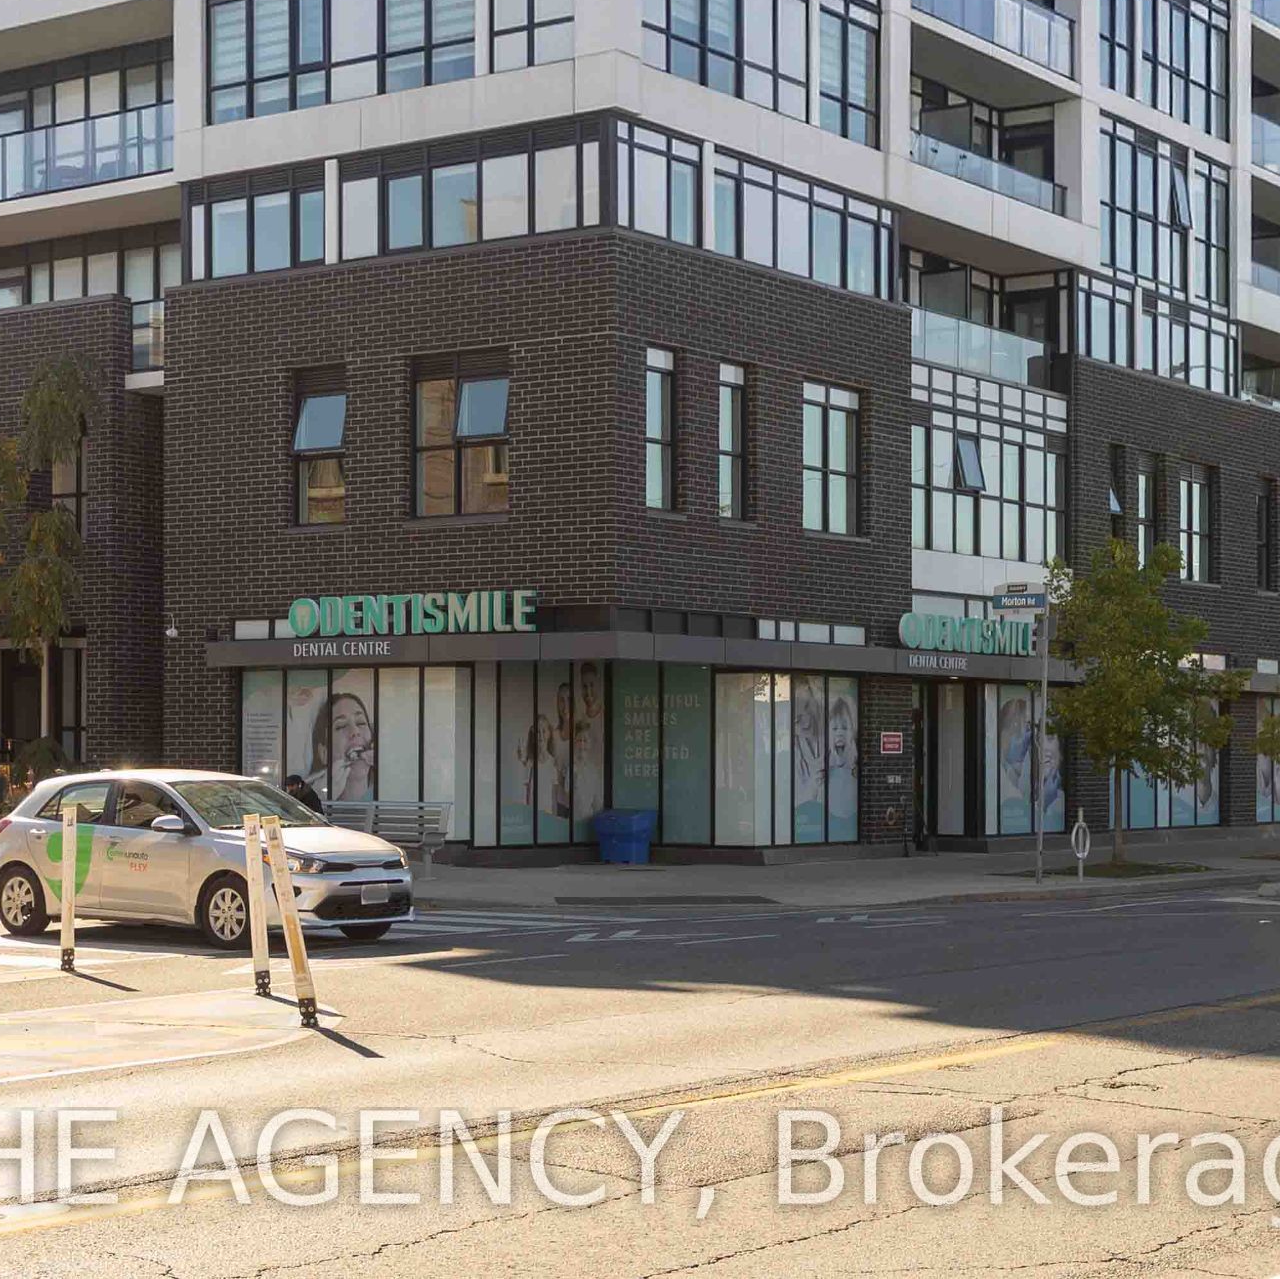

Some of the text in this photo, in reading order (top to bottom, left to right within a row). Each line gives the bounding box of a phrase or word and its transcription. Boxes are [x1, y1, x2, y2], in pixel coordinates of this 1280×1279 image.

[1001, 596, 1026, 606] Morton
[319, 590, 537, 637] DENTISMILE
[919, 613, 1038, 656] DENTISMILE
[293, 641, 391, 657] DENTAL CENTRE
[909, 654, 968, 670] DENTAL CENTRE
[624, 694, 701, 709] BEAUTIFUL
[624, 712, 679, 726] SMILES
[624, 728, 651, 742] ARE
[624, 746, 689, 760] CREATED
[624, 764, 659, 778] HERE
